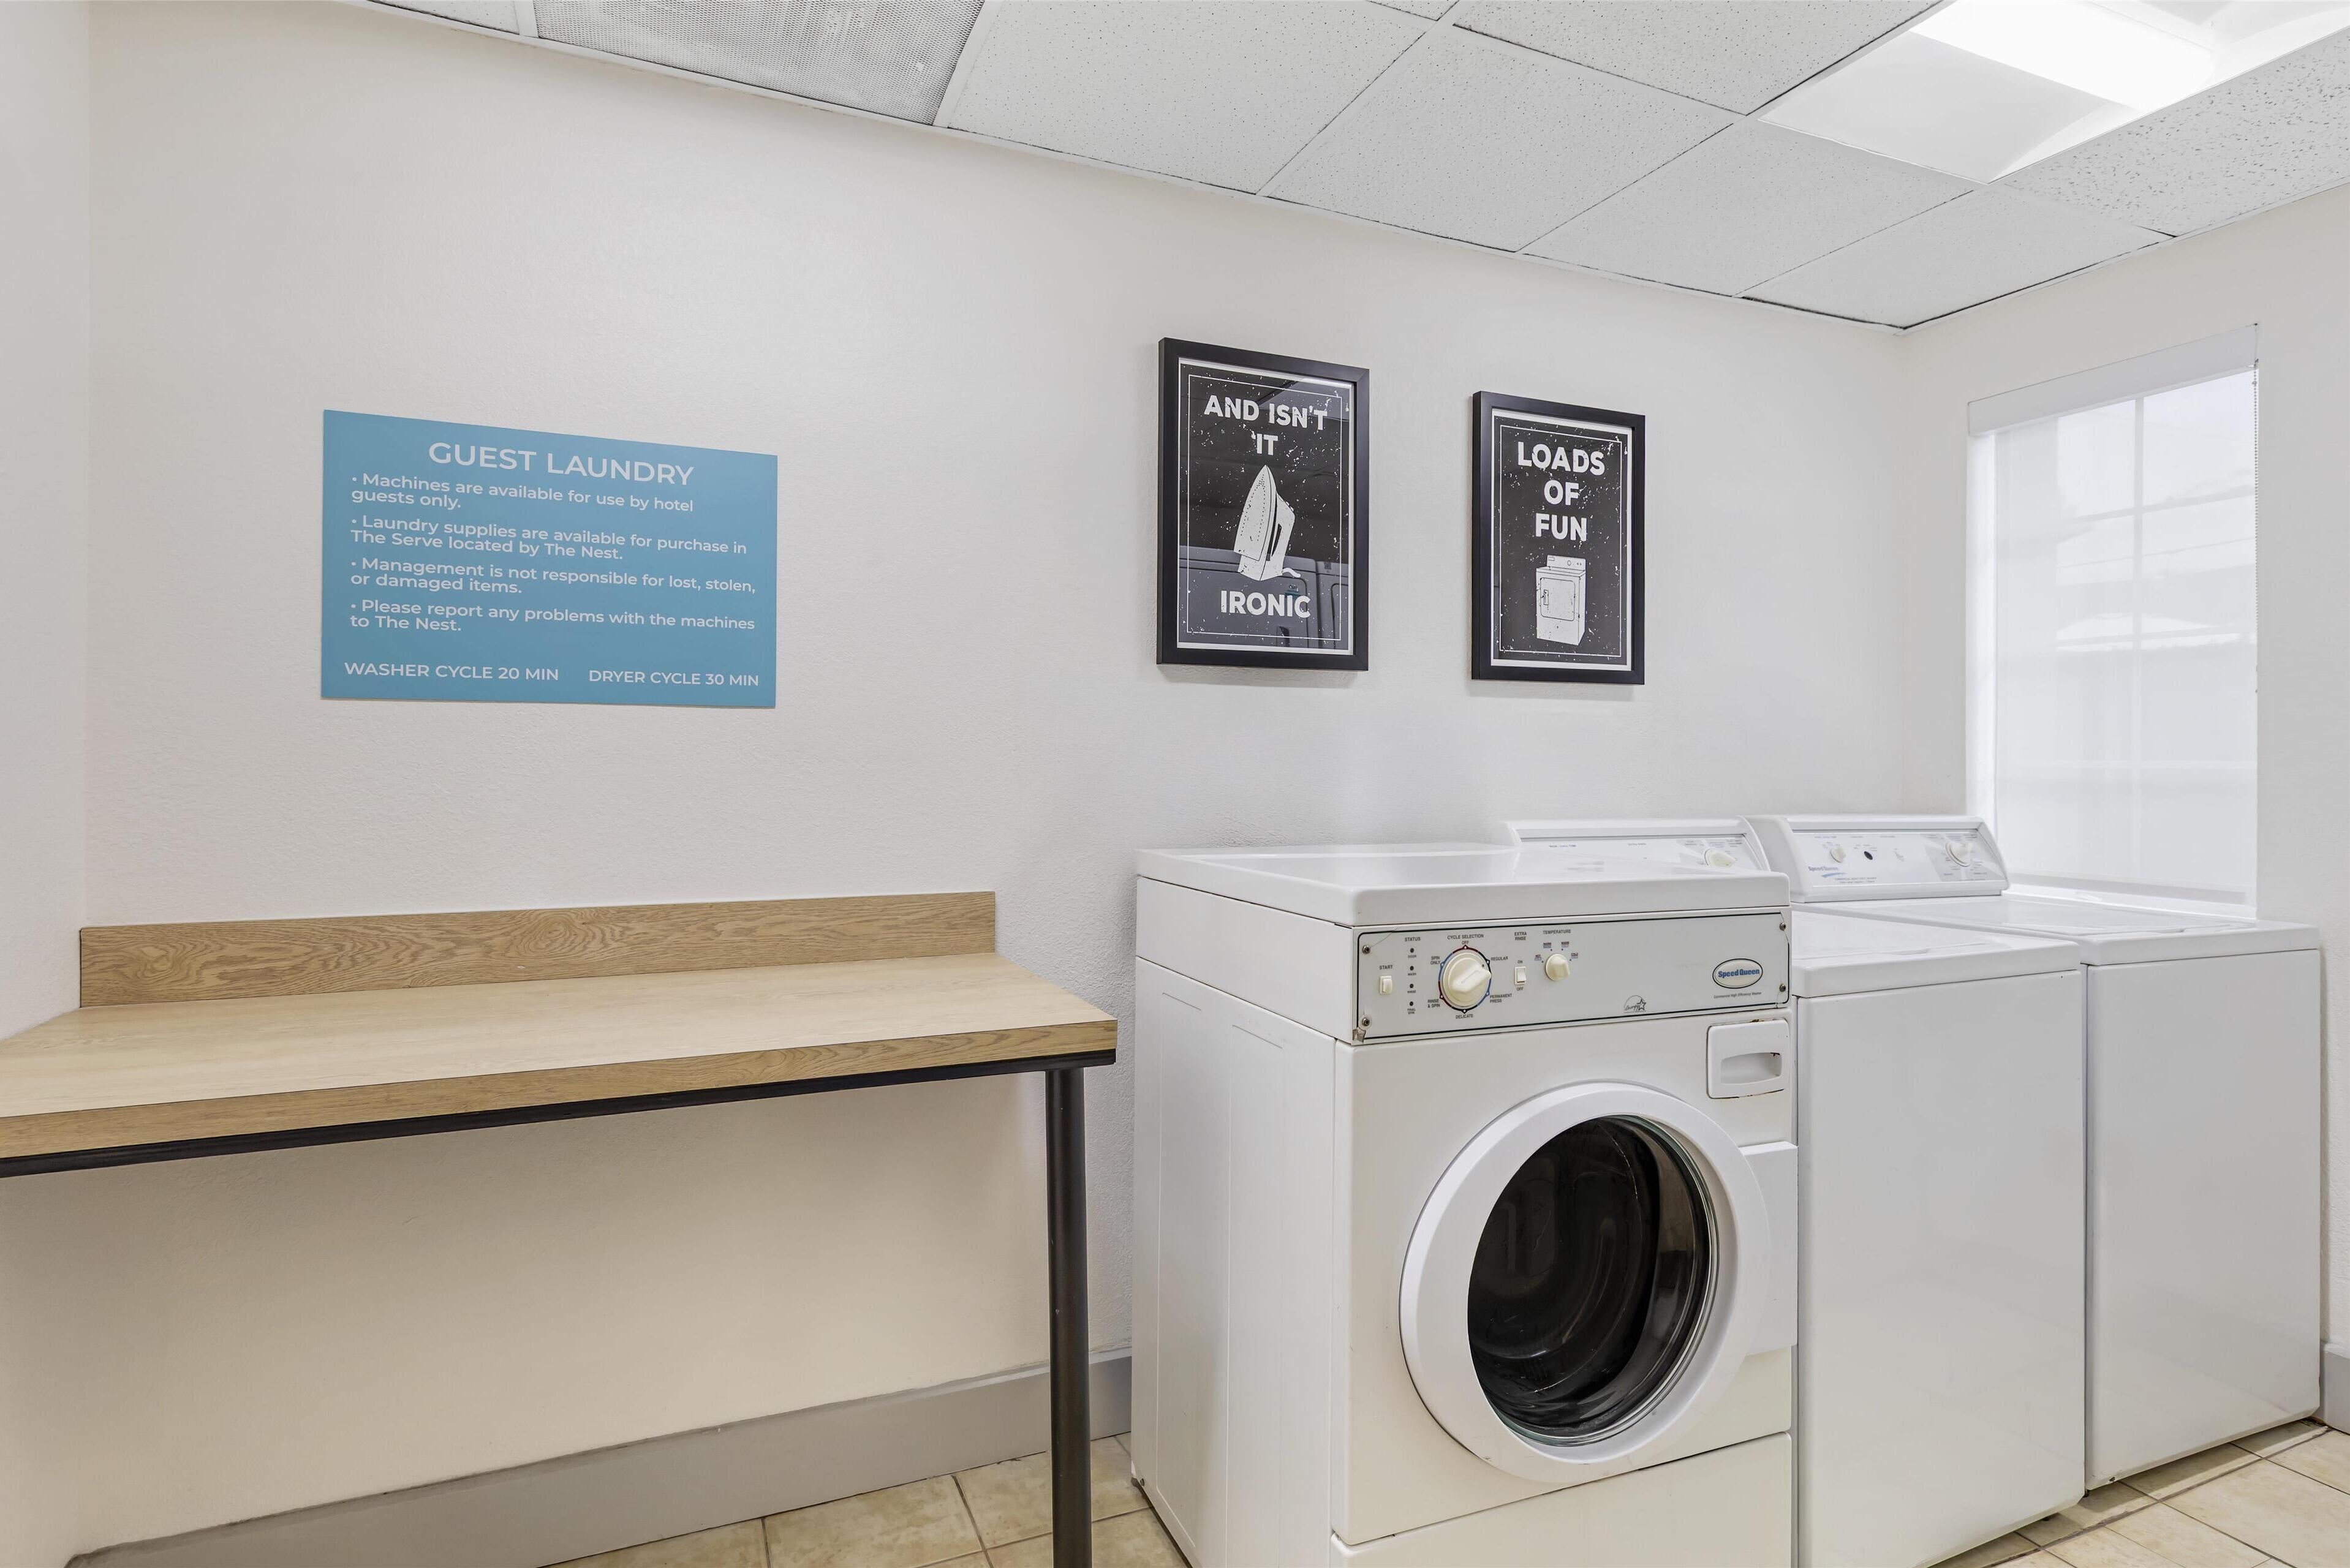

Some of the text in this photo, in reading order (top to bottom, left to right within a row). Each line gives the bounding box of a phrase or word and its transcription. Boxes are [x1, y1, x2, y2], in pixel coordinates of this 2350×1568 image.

[1204, 394, 1328, 431] AND ISN'T
[1256, 433, 1279, 455] IT
[1517, 441, 1605, 475] LOADS
[429, 443, 693, 485] GUEST LAUNDRY
[352, 491, 461, 510] guests only.
[363, 473, 693, 511] Machines are available for use by hotel
[1544, 479, 1579, 506] OF
[363, 515, 746, 554] Laundry supplies are available for purchase in
[1535, 513, 1587, 541] FUN
[350, 530, 622, 559] The Serve located by The Nest.
[351, 574, 521, 593] or damaged items.
[363, 557, 755, 594] Management is not responsible for lost, stolen,
[363, 600, 755, 629] Please report any problems with the machines
[1221, 590, 1311, 619] IRONIC
[350, 616, 461, 631] to The Nest.
[344, 663, 558, 680] WASHER CYCLE 20 MIN
[589, 670, 758, 686] DRYER CYCLE 30 MIN
[1718, 969, 1739, 978] Speed
